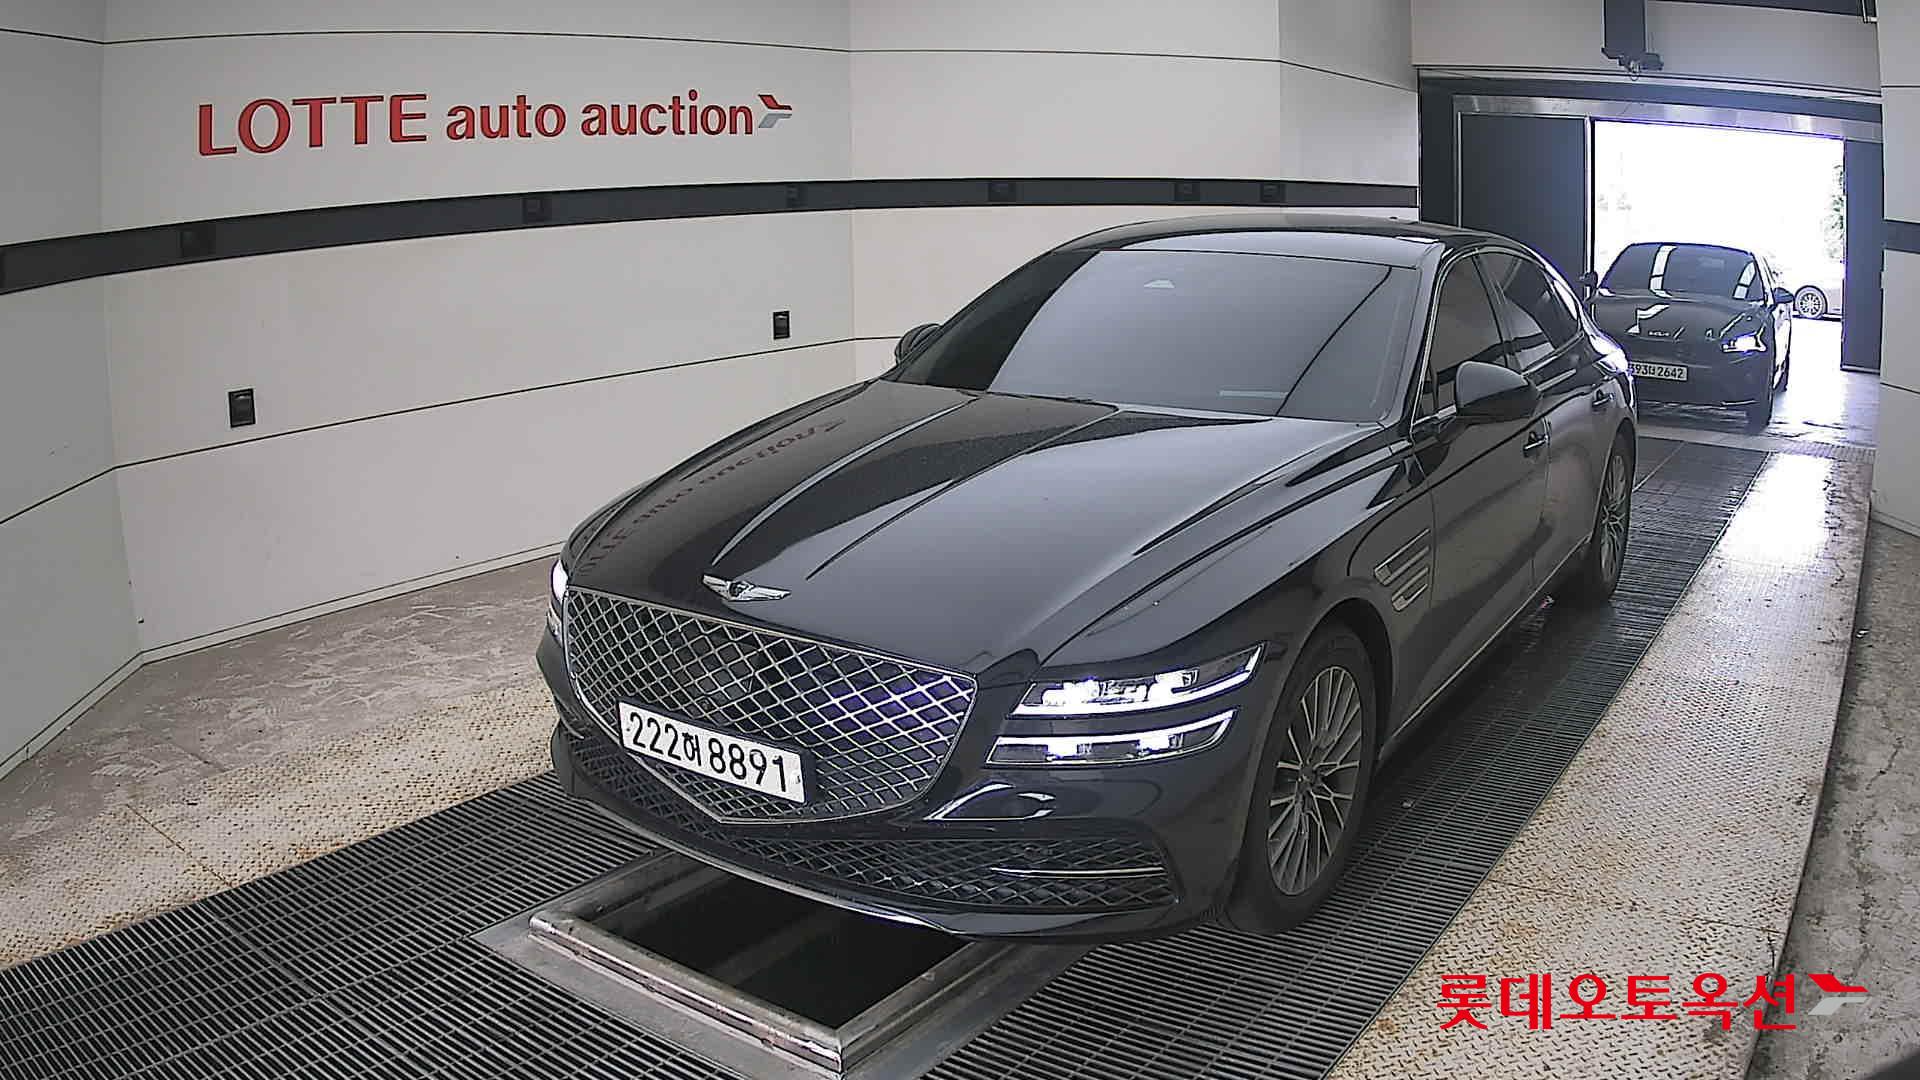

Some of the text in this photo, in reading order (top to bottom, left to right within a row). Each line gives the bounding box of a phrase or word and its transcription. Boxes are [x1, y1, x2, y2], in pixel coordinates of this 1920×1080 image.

[199, 90, 754, 156] LOTTE auto auction
